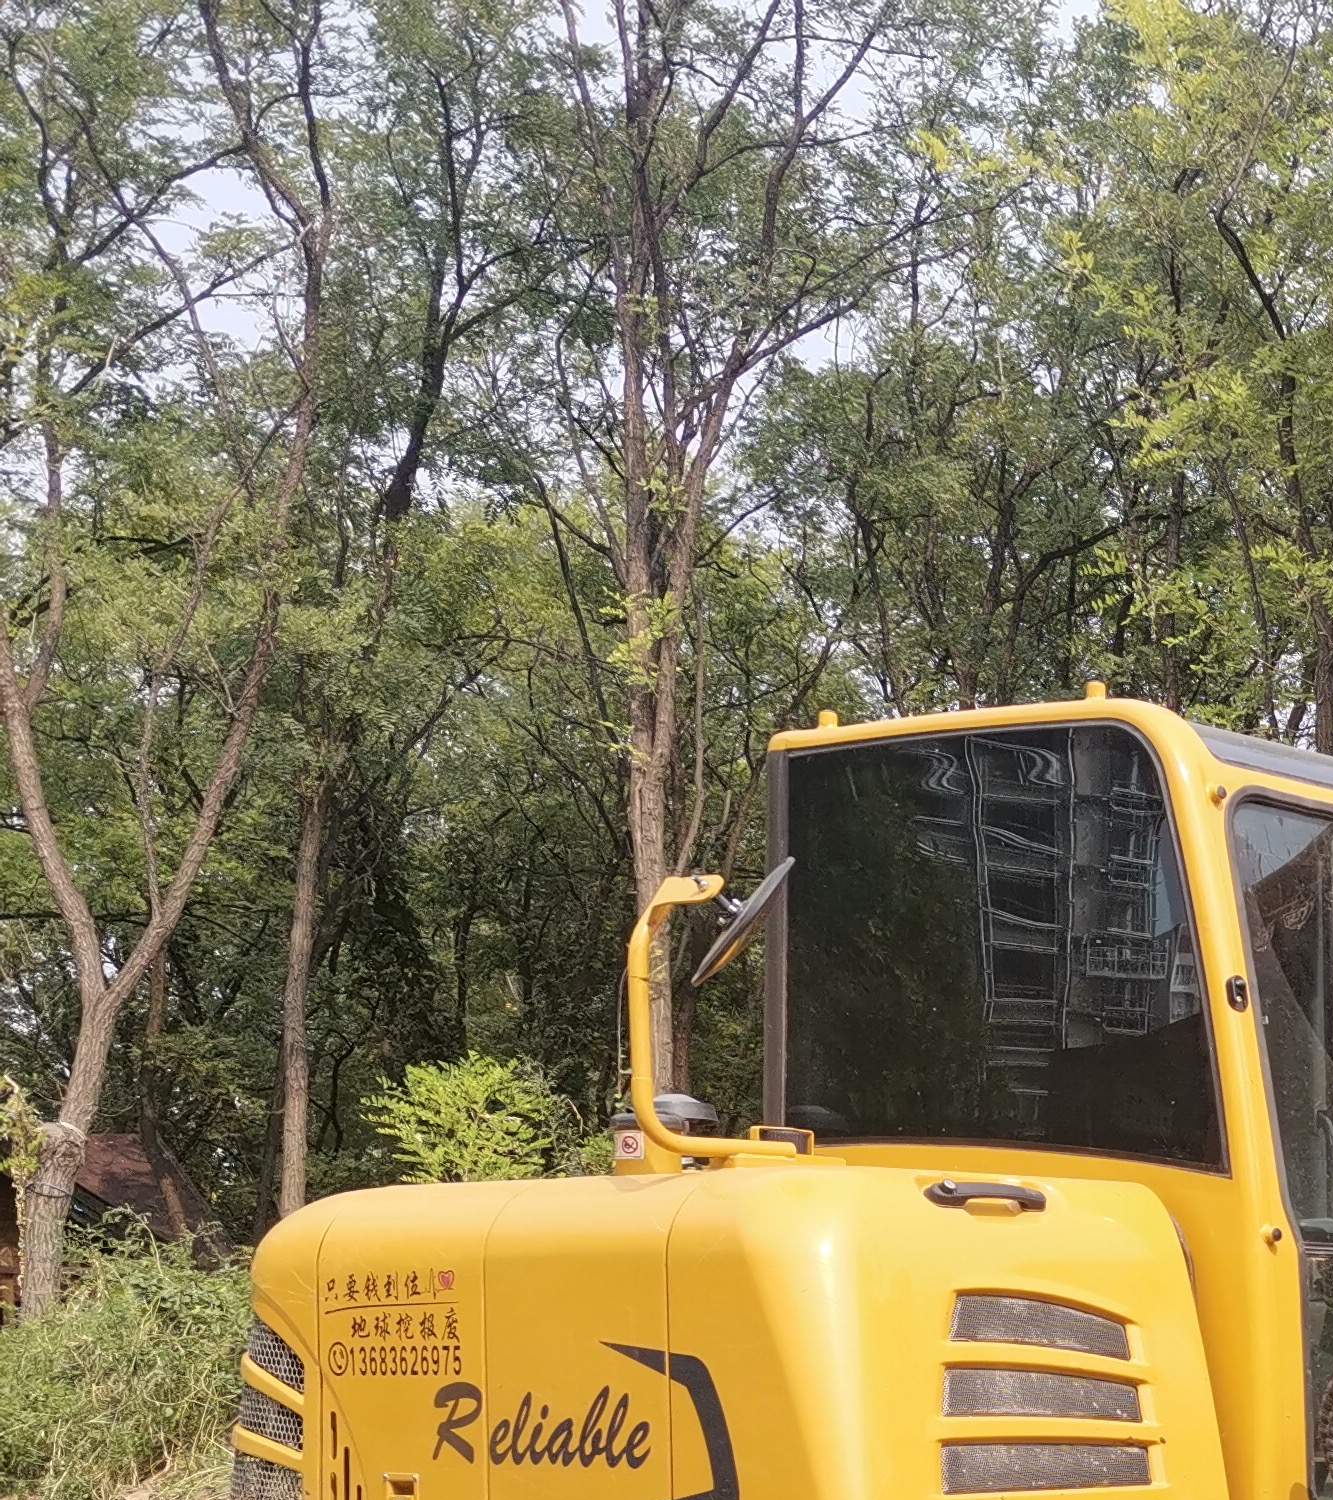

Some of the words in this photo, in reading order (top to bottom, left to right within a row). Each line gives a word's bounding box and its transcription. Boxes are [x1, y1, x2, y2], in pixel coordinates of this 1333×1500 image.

[324, 1271, 421, 1302] 只要钱到位
[350, 1345, 462, 1376] 13683626975
[432, 1381, 651, 1469] Reliable
